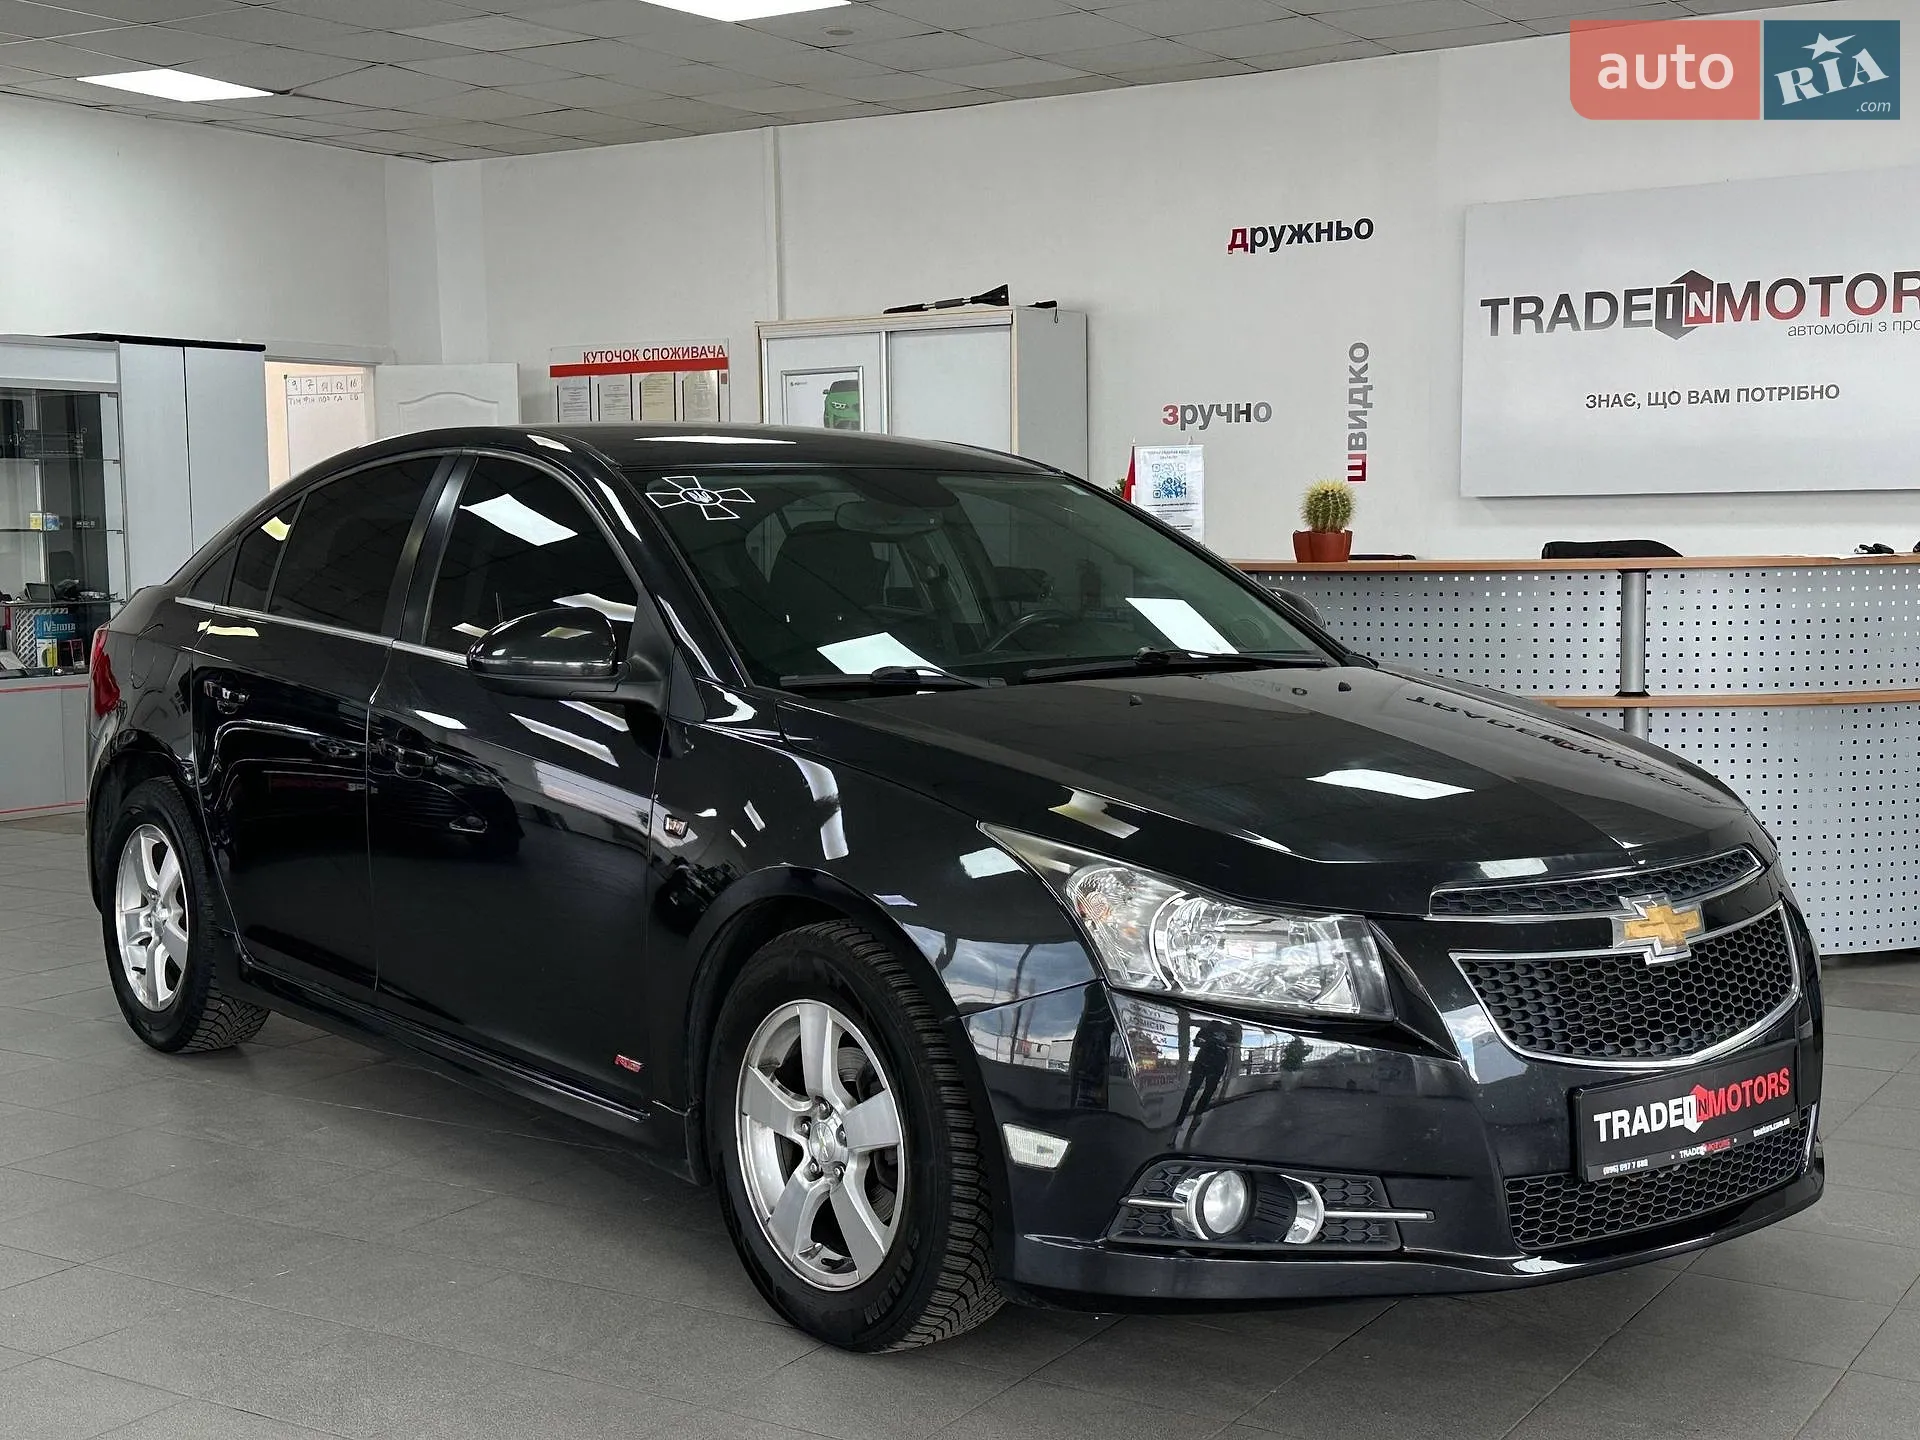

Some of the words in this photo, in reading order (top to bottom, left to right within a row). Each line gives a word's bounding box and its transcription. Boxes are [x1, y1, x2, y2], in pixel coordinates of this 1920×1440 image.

[1228, 217, 1374, 254] дружньо
[1788, 319, 1873, 337] автомобілі
[1878, 321, 1887, 332] з
[583, 347, 639, 364] КУТОЧОК
[642, 345, 725, 362] СПОЖИВАЧА
[1586, 392, 1641, 412] ЗНАЄ,
[1648, 389, 1681, 408] ЩО
[1687, 387, 1730, 406] ВАМ
[1737, 383, 1840, 404] ПОТРІБНО
[1162, 402, 1273, 431] зручно
[1347, 342, 1373, 483] швидко
